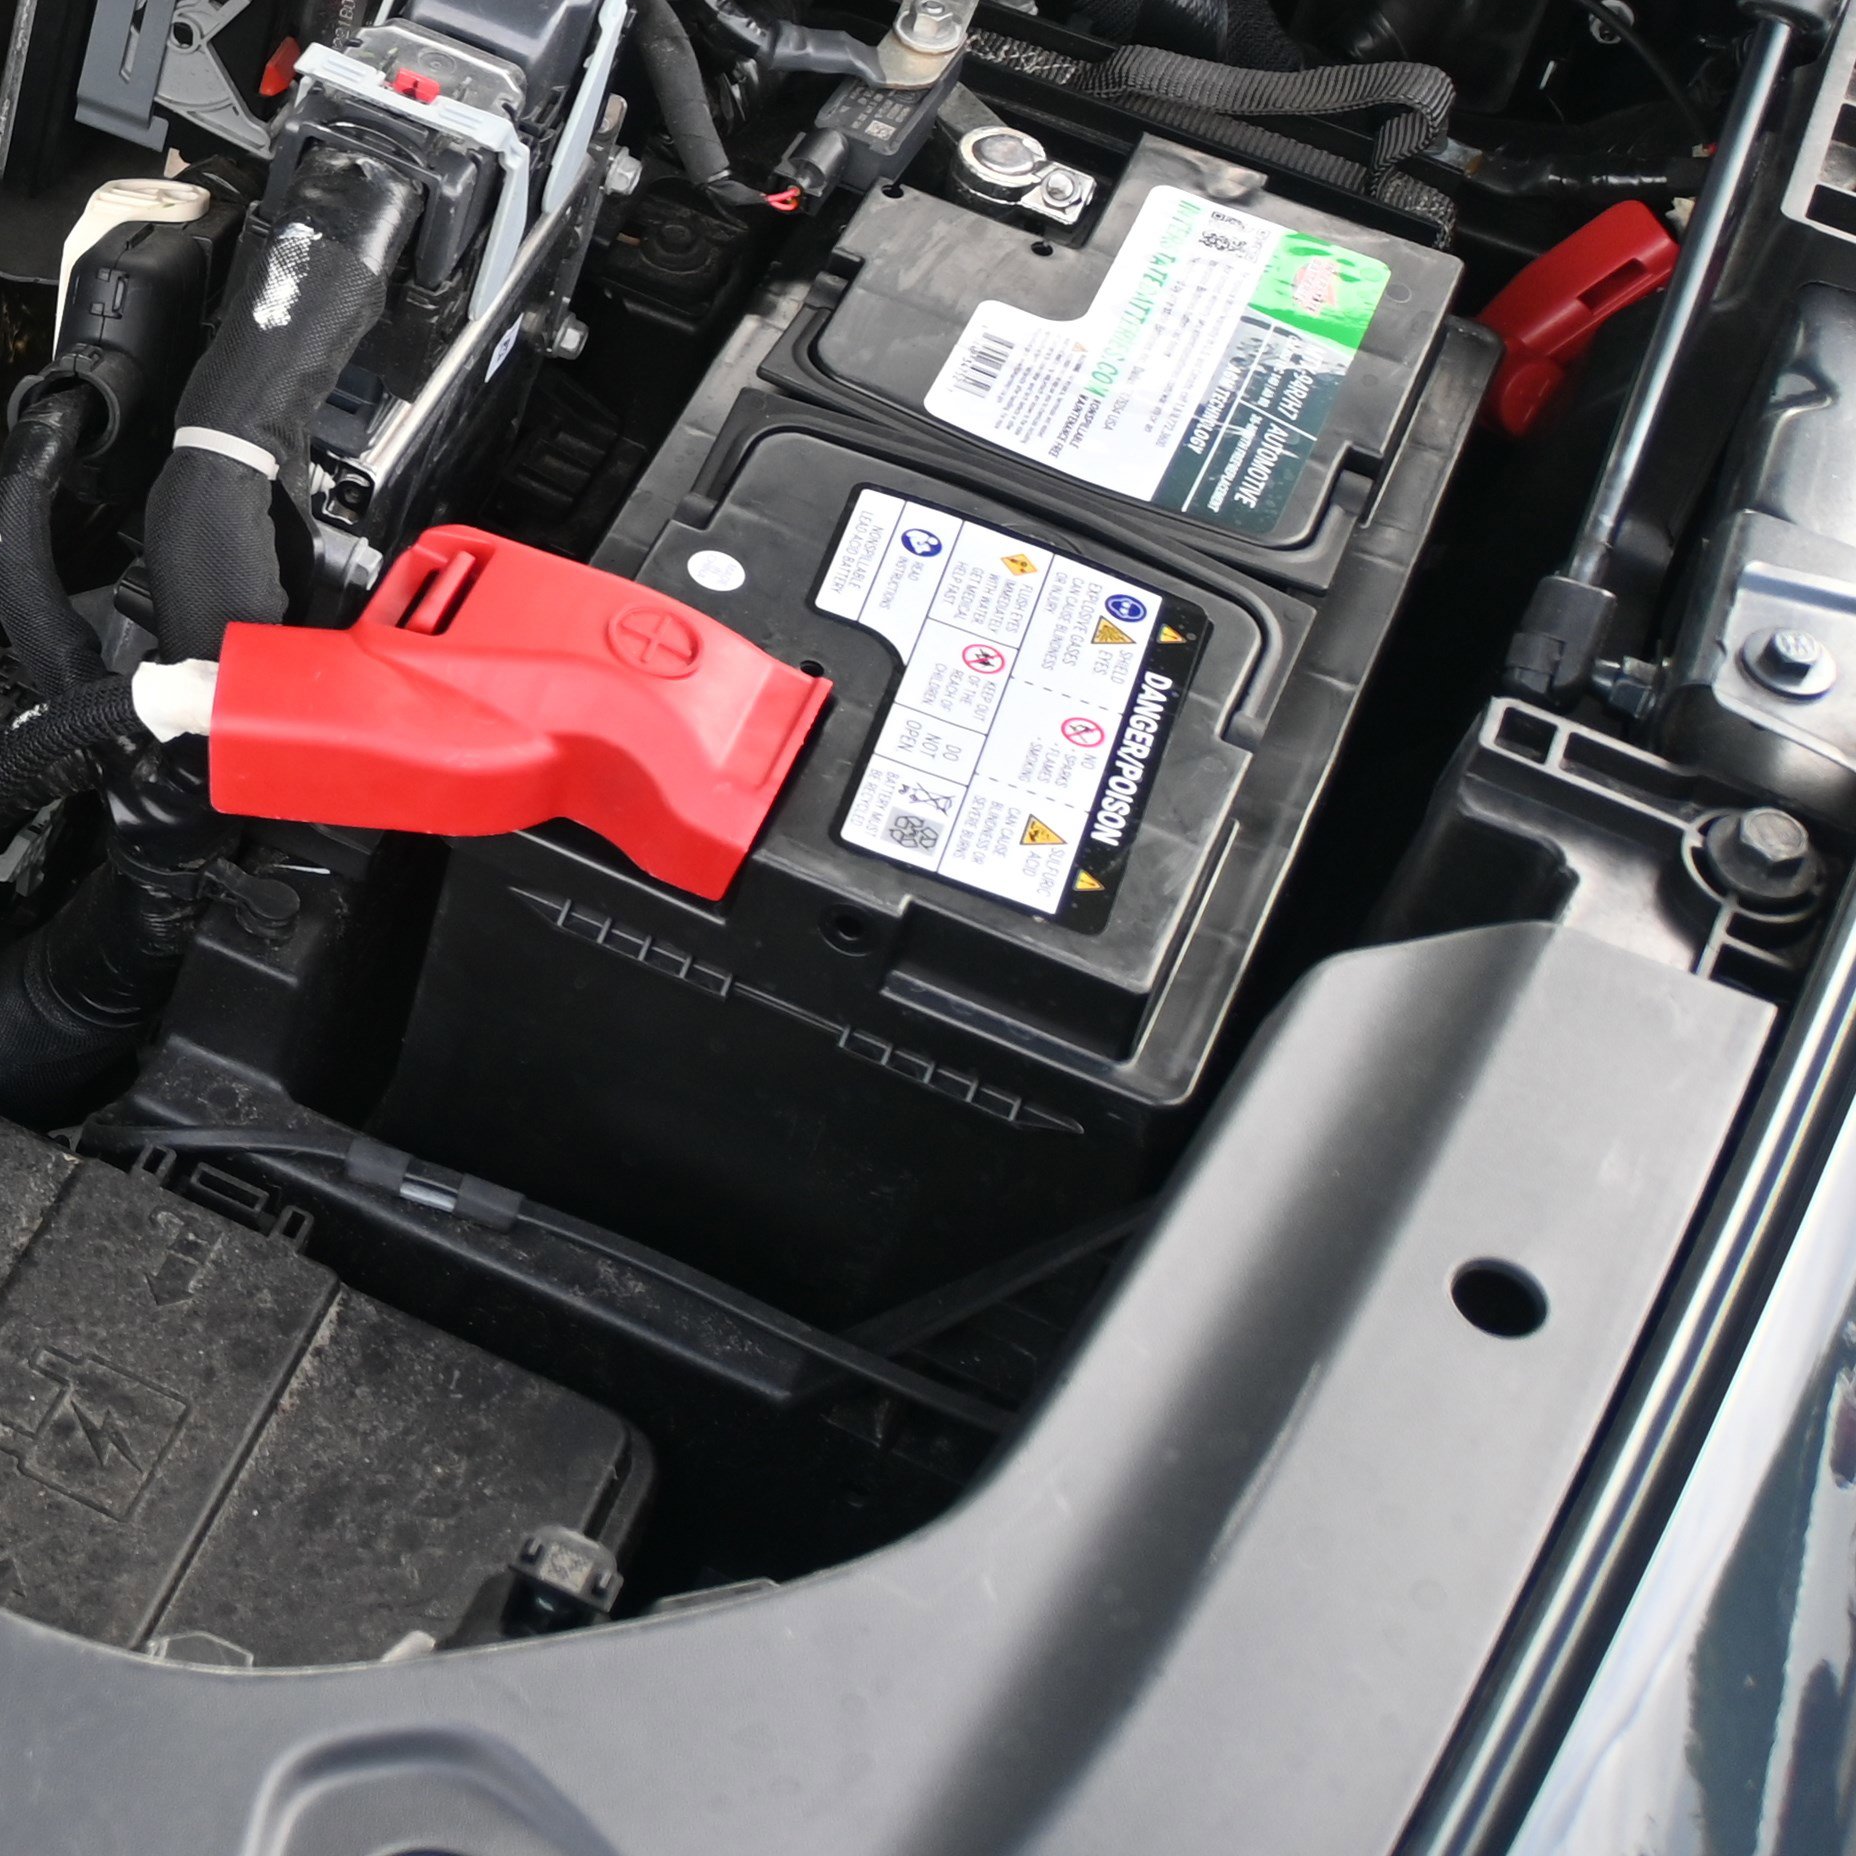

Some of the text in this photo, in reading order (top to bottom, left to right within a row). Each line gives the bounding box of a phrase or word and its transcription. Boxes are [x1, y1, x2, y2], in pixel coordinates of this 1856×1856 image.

[1068, 397, 1103, 449] NONSPILLABLE
[1185, 386, 1230, 455] TECHNOLOGY
[1232, 422, 1290, 509] AUTOMOTIVE
[826, 508, 875, 594] LEAD ACID BATTERY
[845, 523, 885, 590] NONSPILLABLE
[906, 559, 924, 582] READ
[948, 559, 969, 585] HELP
[1053, 569, 1068, 585] OR
[877, 553, 911, 611] INSTRUCTIONS
[952, 565, 985, 622] GET MEDICAL
[981, 571, 1001, 596] WITH
[985, 576, 1017, 635] IMMEDIATELY
[1004, 582, 1034, 635] FLUSH EYES
[1039, 575, 1085, 672] CAN CAUSE BLINDNESS
[1060, 580, 1103, 668] EXPLOSIVE GASES
[940, 667, 964, 702] REACH
[1108, 647, 1134, 686] SHIELD
[958, 686, 976, 706] THE
[971, 679, 998, 722] KEEP OUT
[917, 731, 943, 760] NOT
[940, 742, 963, 763] DO
[1016, 739, 1043, 784] SMOKING
[1035, 745, 1060, 784] FLAMES
[1052, 751, 1077, 789] SPARKS
[1079, 752, 1098, 771] NO
[1089, 670, 1170, 848] DANGER/POISON
[848, 779, 878, 828] RECYCLED
[862, 769, 900, 838] BATTERY MUST
[951, 793, 987, 861] SEVERE BURNS
[974, 799, 1004, 852] BLINDNESS
[991, 805, 1021, 858] CAN CAUSE
[1020, 849, 1041, 878] ACID
[1034, 845, 1066, 899] SULFURIC
